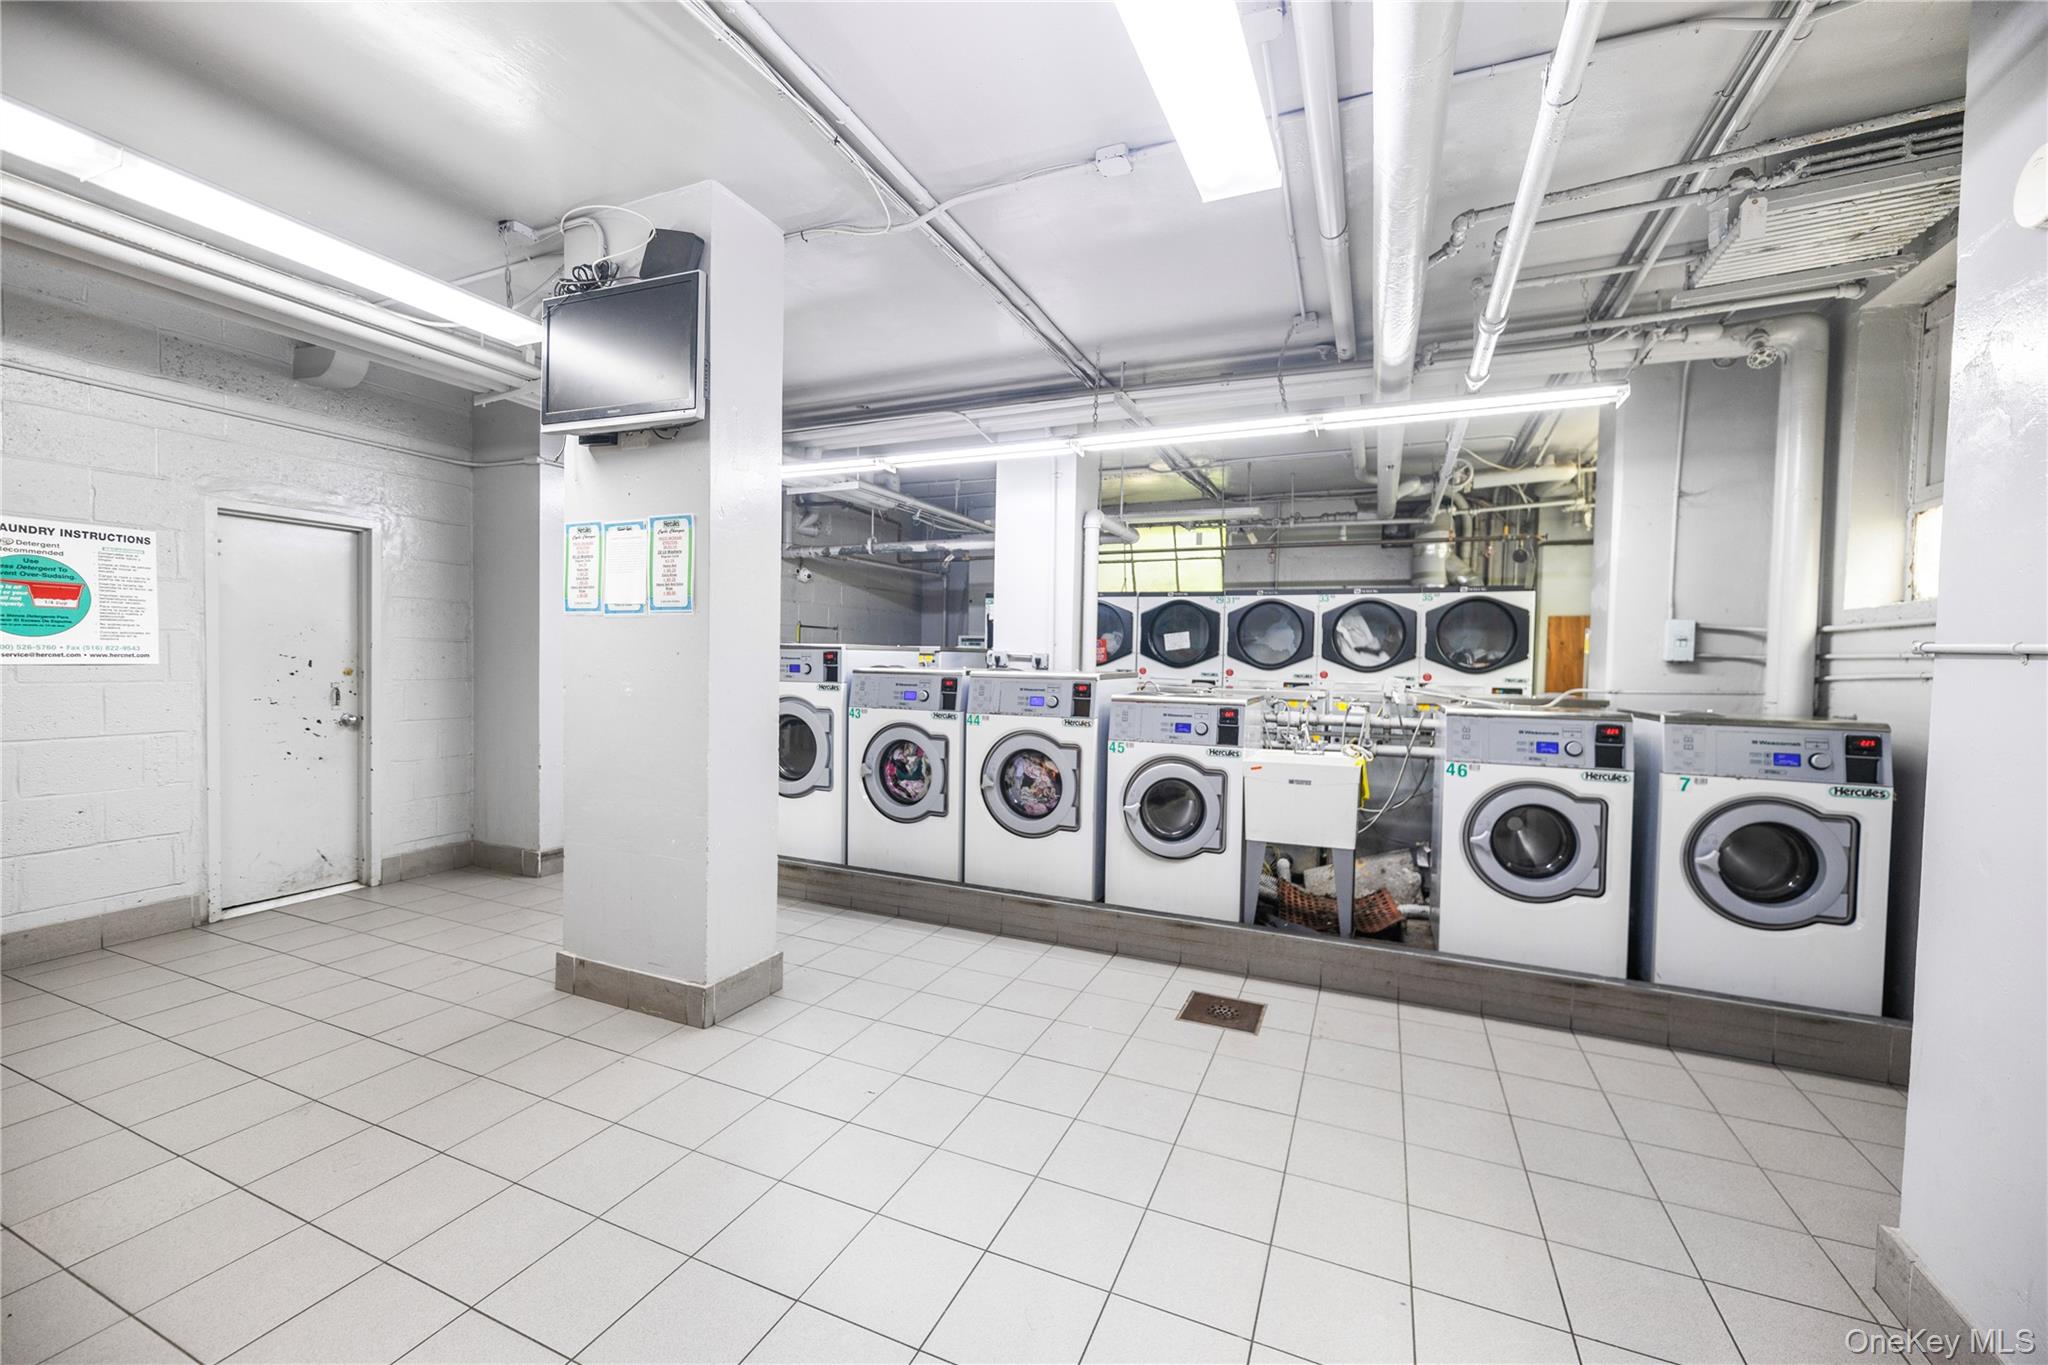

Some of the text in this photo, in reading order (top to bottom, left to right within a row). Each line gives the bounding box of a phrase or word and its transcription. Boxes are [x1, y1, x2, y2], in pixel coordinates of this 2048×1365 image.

[60, 528, 151, 545] INSTRUCTIONS
[16, 538, 60, 549] Detergent
[0, 545, 64, 556] ecommended
[16, 564, 57, 572] Detergent
[849, 708, 862, 719] 43
[933, 712, 957, 720] Hercules
[966, 714, 981, 726] 44
[1064, 719, 1092, 727] Hercules
[1109, 742, 1125, 753] 45
[1209, 749, 1240, 757] Hercules
[1446, 763, 1468, 777] 46
[1585, 772, 1628, 782] Hercules
[1679, 777, 1690, 792] 7
[1834, 787, 1887, 799] Hercules
